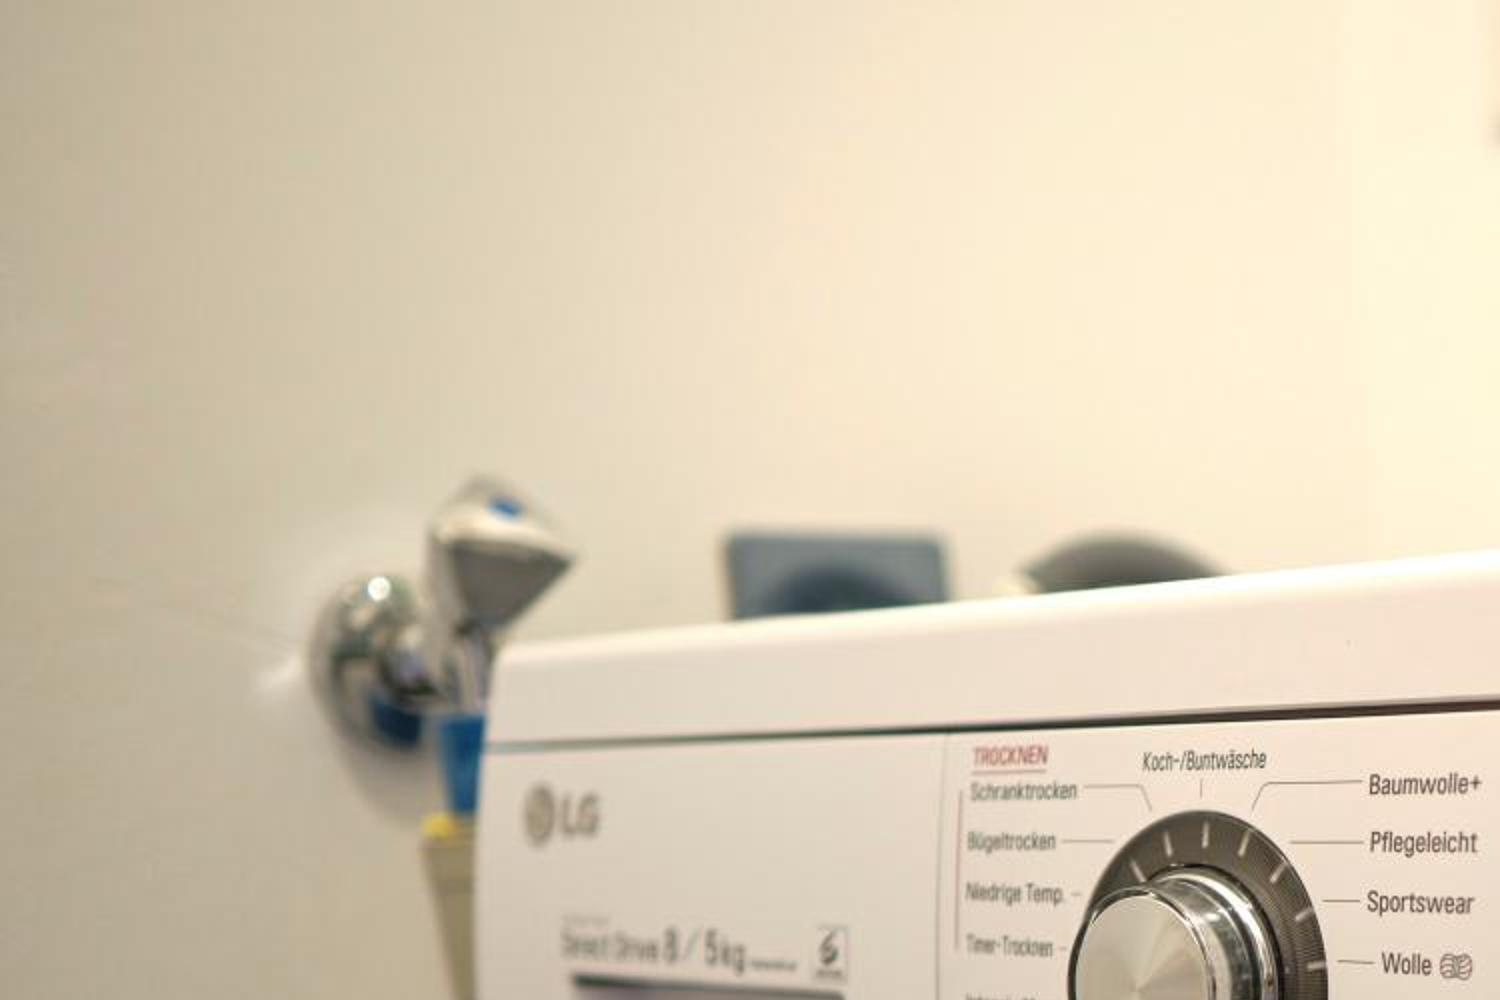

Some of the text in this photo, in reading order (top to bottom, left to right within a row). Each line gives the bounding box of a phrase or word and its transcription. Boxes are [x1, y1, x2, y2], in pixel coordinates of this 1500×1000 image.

[974, 744, 1049, 766] TROCKNEN
[1142, 749, 1267, 771] Koch-/Buntwäsche
[970, 781, 1077, 801] Schranktrocken
[1368, 772, 1482, 796] Baumwolle+
[967, 832, 1057, 854] Bügeltrocken
[1369, 830, 1478, 858] Pflegeleicht
[965, 882, 1021, 906] Niedrige
[1366, 890, 1476, 917] Sportswear
[1381, 951, 1433, 977] Wolle
